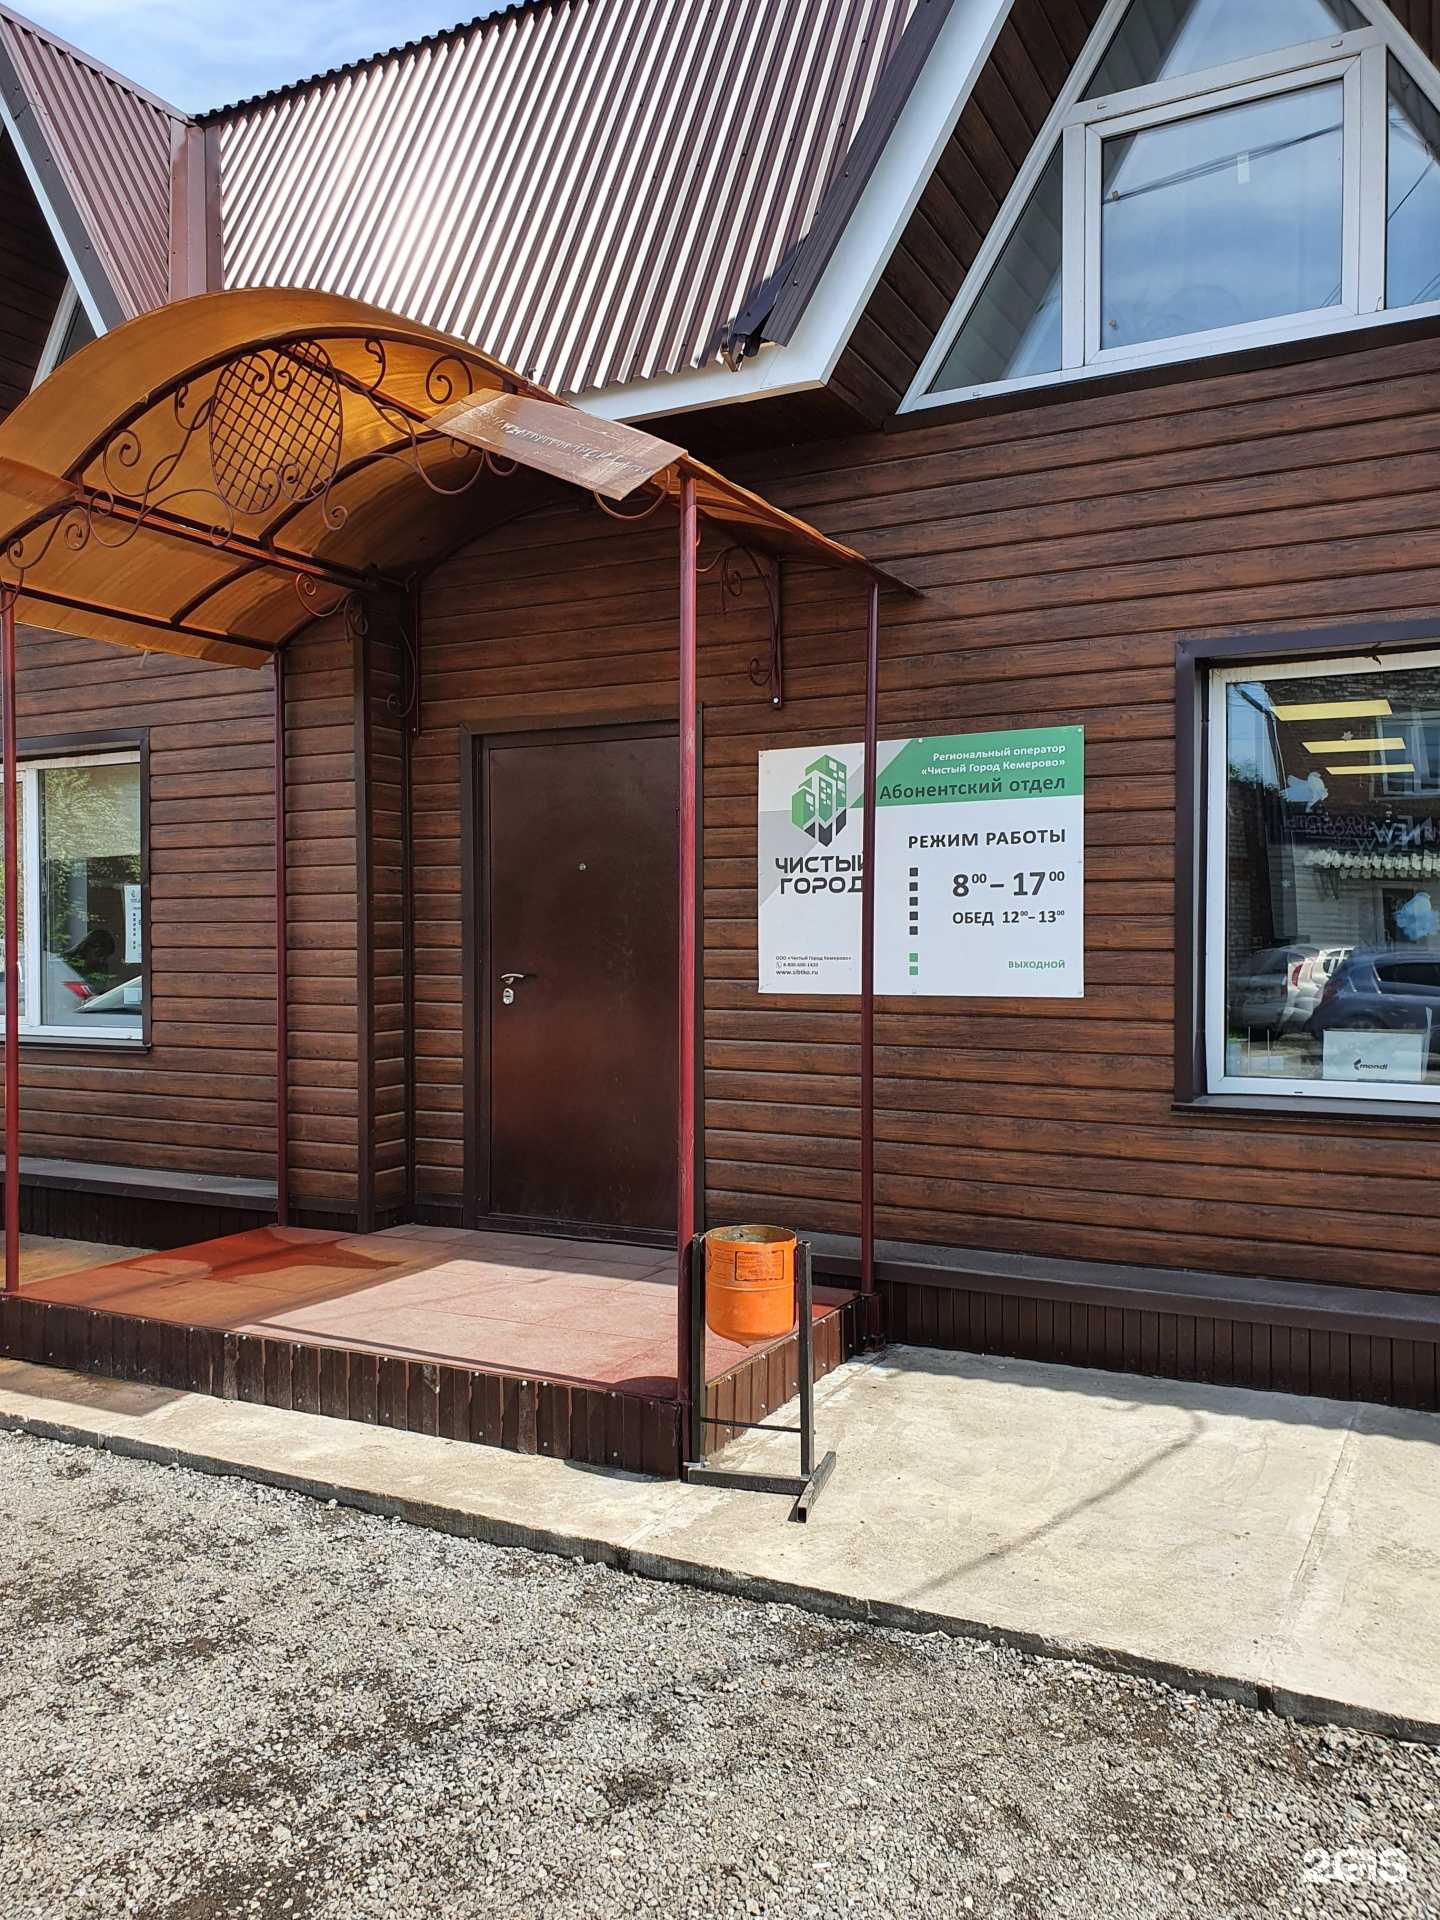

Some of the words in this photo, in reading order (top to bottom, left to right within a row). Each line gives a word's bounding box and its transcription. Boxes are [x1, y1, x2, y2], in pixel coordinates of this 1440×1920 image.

[933, 746, 1011, 761] Региональный
[1013, 744, 1066, 758] оператор
[921, 762, 967, 776] «Чистый
[969, 763, 1001, 774] Город
[1002, 758, 1066, 771] Кемерово»
[879, 778, 1003, 800] Абонентский
[1009, 777, 1066, 795] отдел
[908, 832, 979, 849] РЕЖИМ
[986, 829, 1066, 847] РАБОТЫ
[952, 911, 995, 926] ОБЕД
[1008, 959, 1066, 970] ВЫХОДНОЙ
